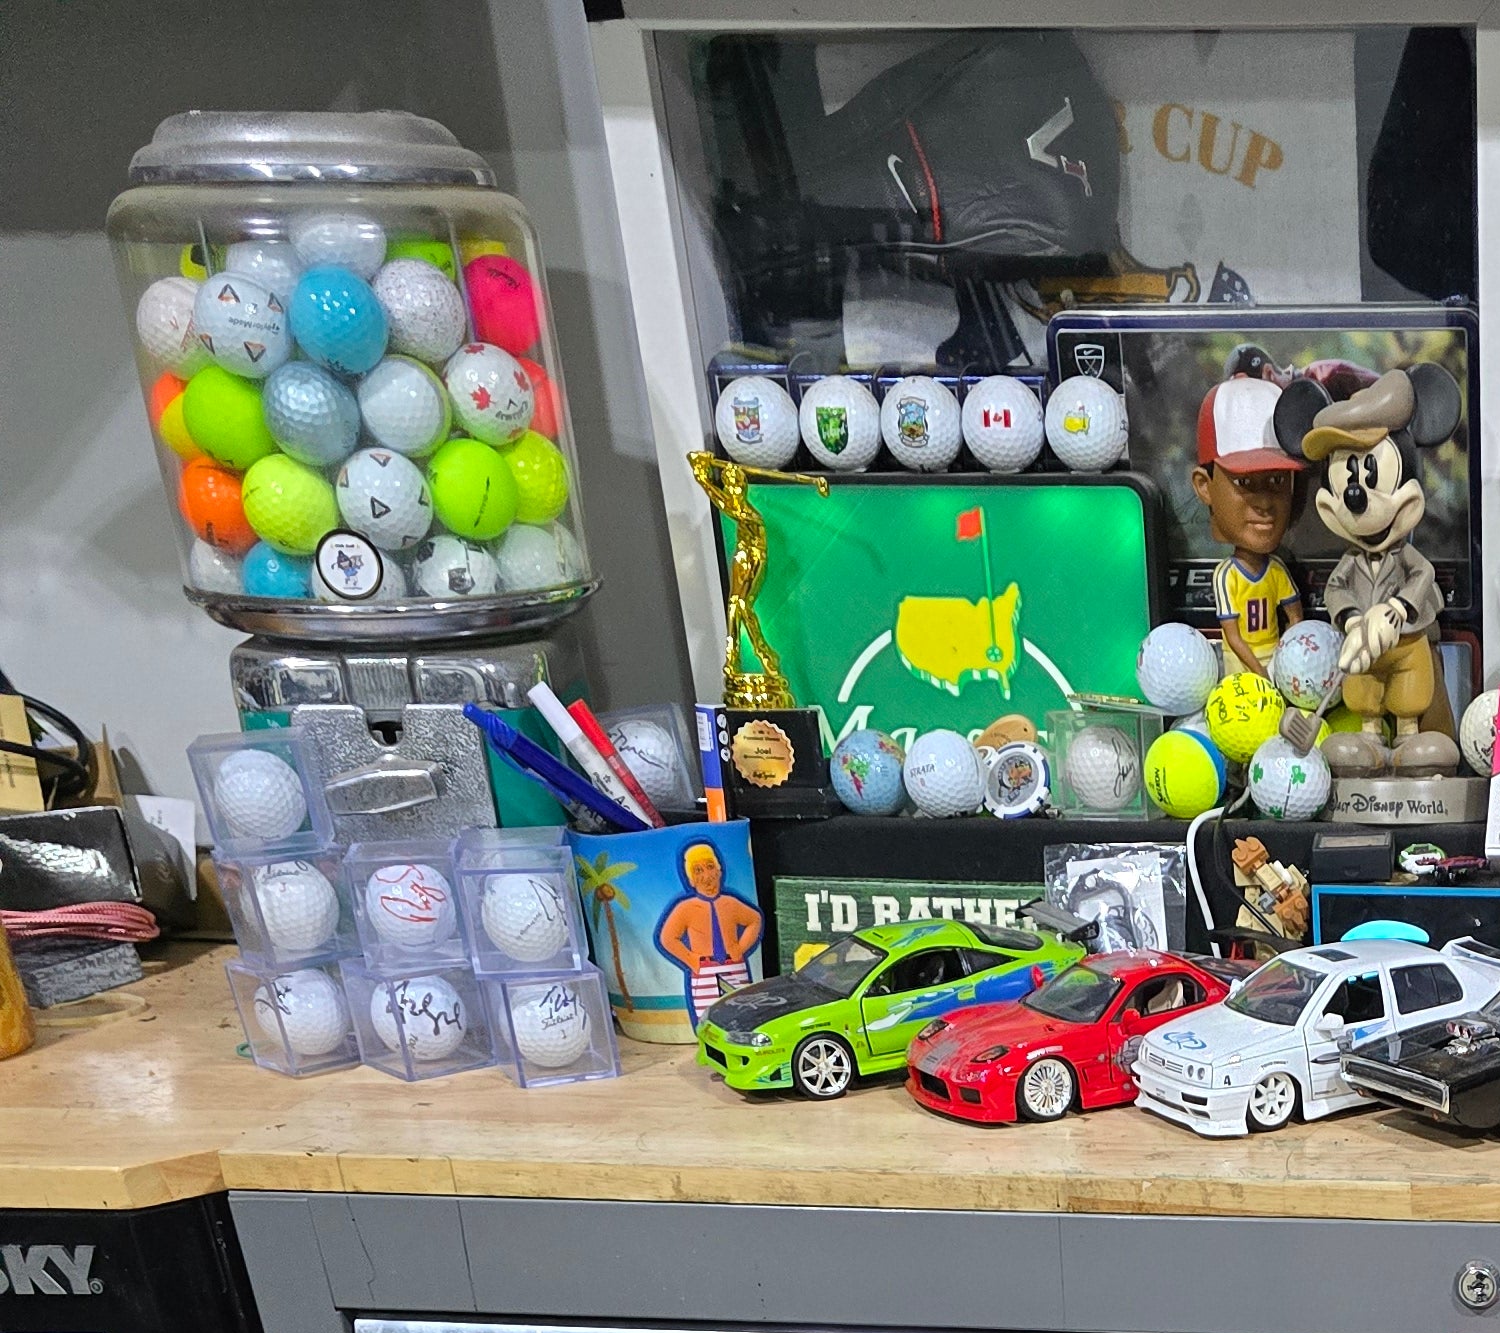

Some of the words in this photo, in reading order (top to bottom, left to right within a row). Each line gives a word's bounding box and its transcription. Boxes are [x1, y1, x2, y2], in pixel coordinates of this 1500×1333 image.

[1153, 102, 1284, 190] CUP
[1246, 598, 1269, 633] 81
[908, 763, 936, 779] STRATA
[1407, 796, 1447, 815] World
[805, 891, 859, 931] I'D
[872, 897, 1037, 931] RATHE
[0, 1244, 97, 1295] KY
